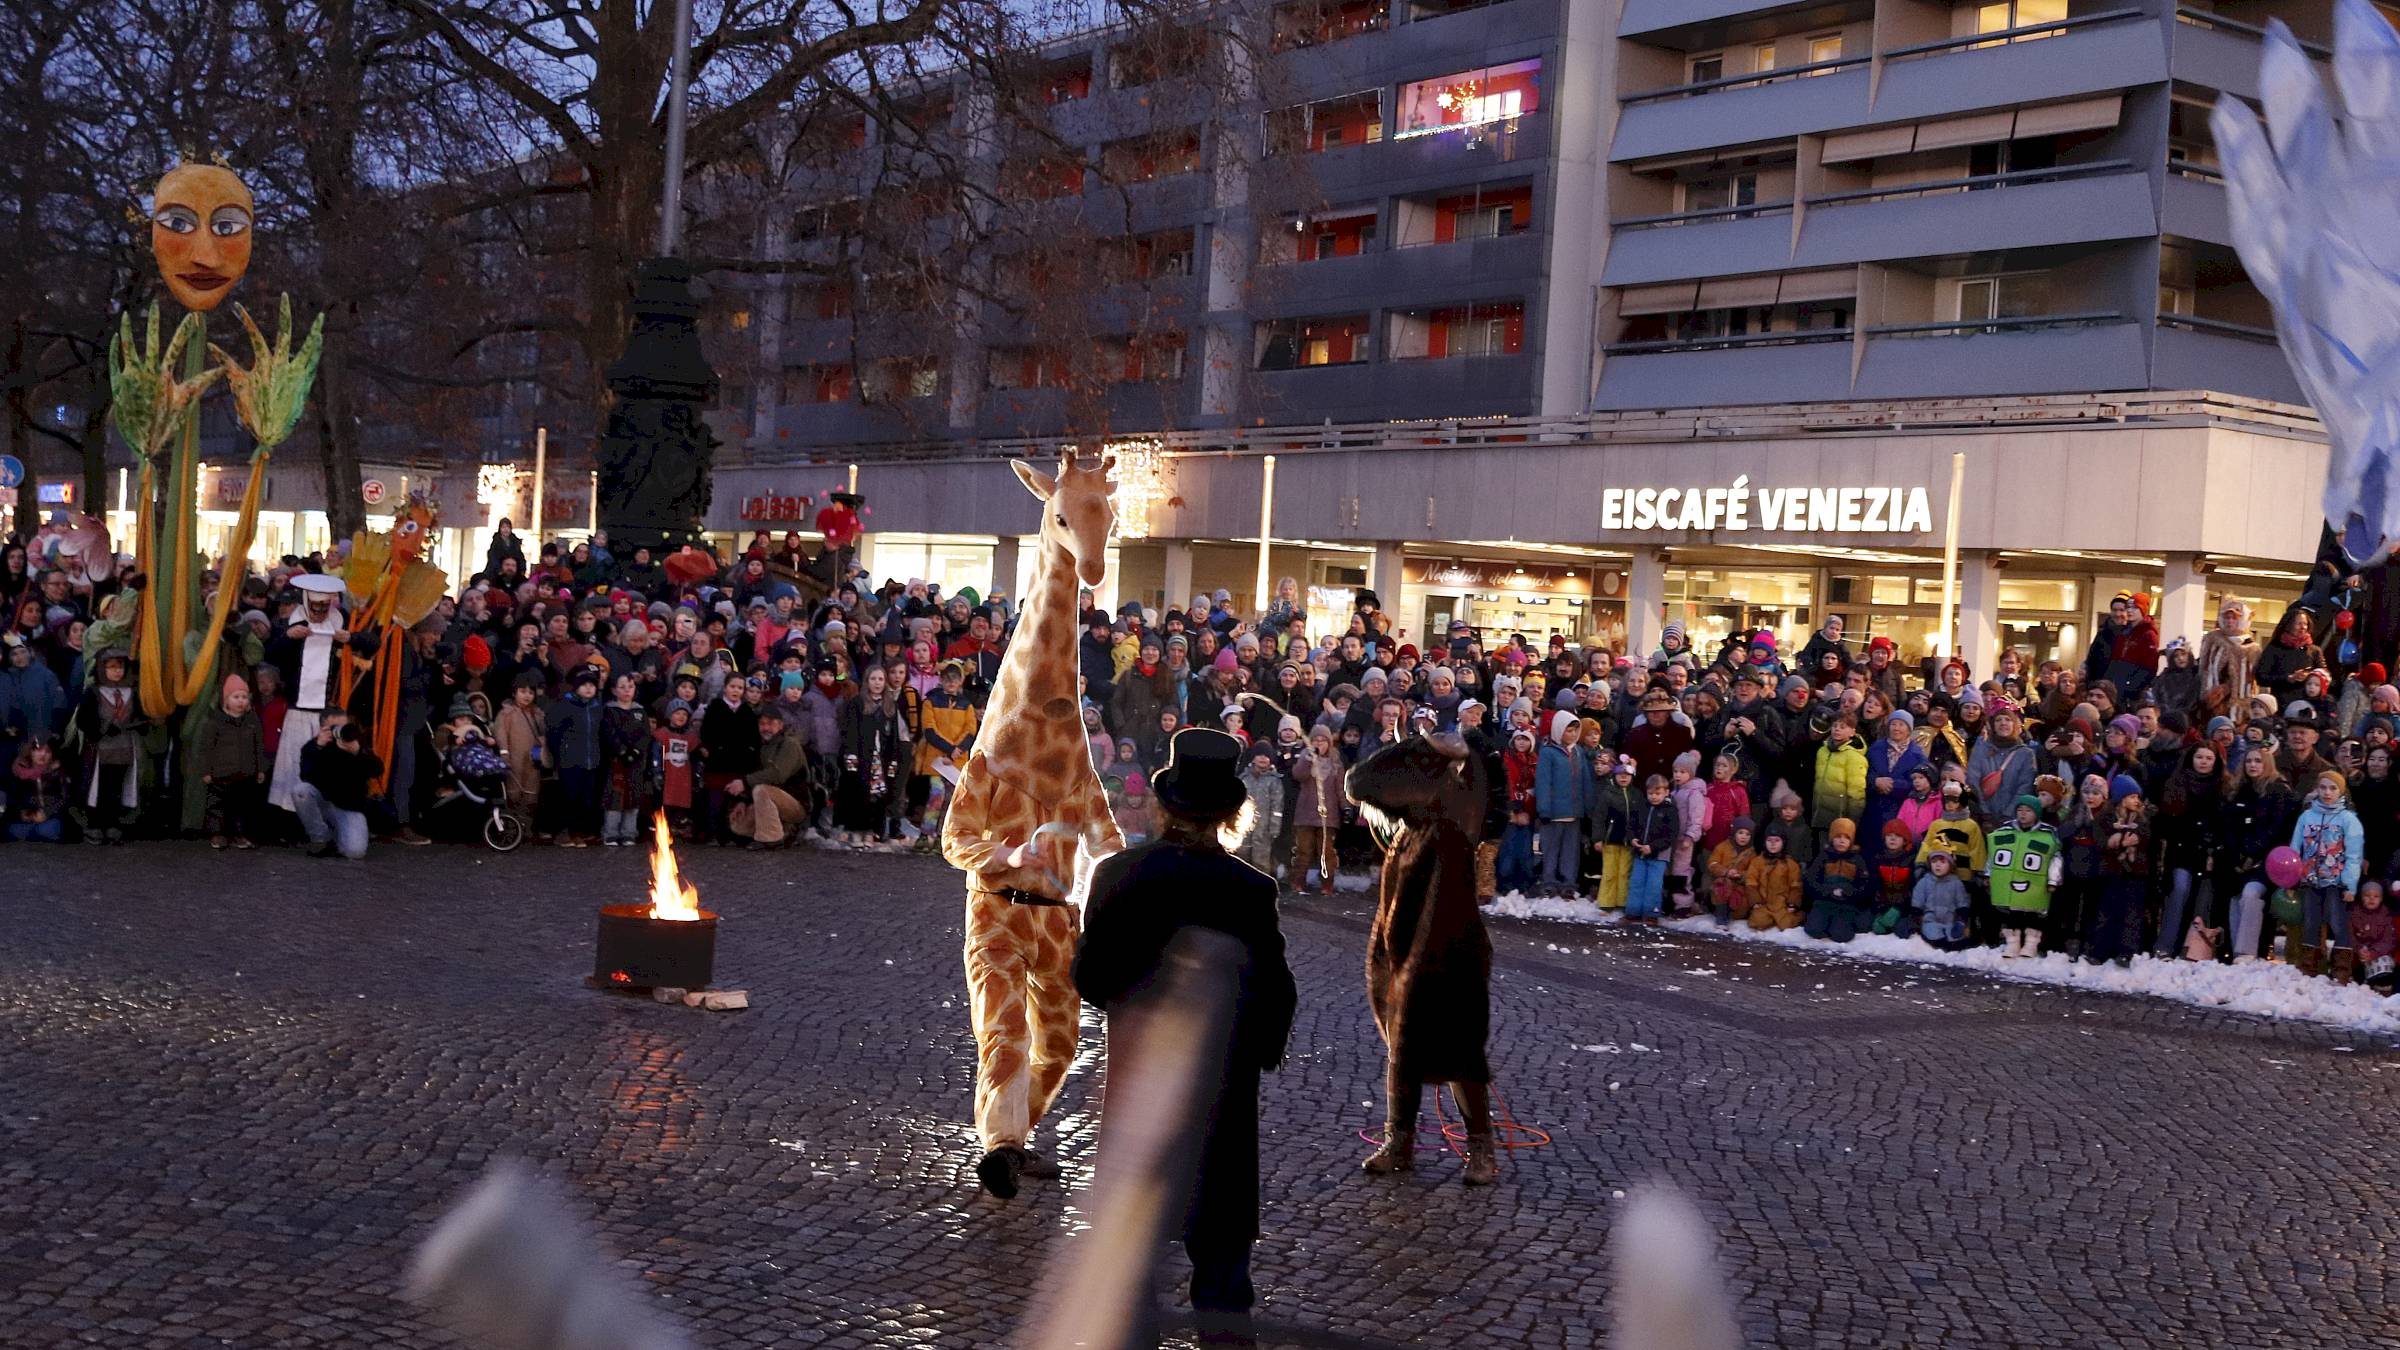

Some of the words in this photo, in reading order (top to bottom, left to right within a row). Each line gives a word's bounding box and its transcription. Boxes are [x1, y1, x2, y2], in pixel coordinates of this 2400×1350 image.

[741, 488, 813, 521] Leiser
[1601, 474, 1750, 531] EISCAFÉ
[1758, 487, 1932, 533] VENEZIA
[1488, 571, 1554, 588] italisch.
